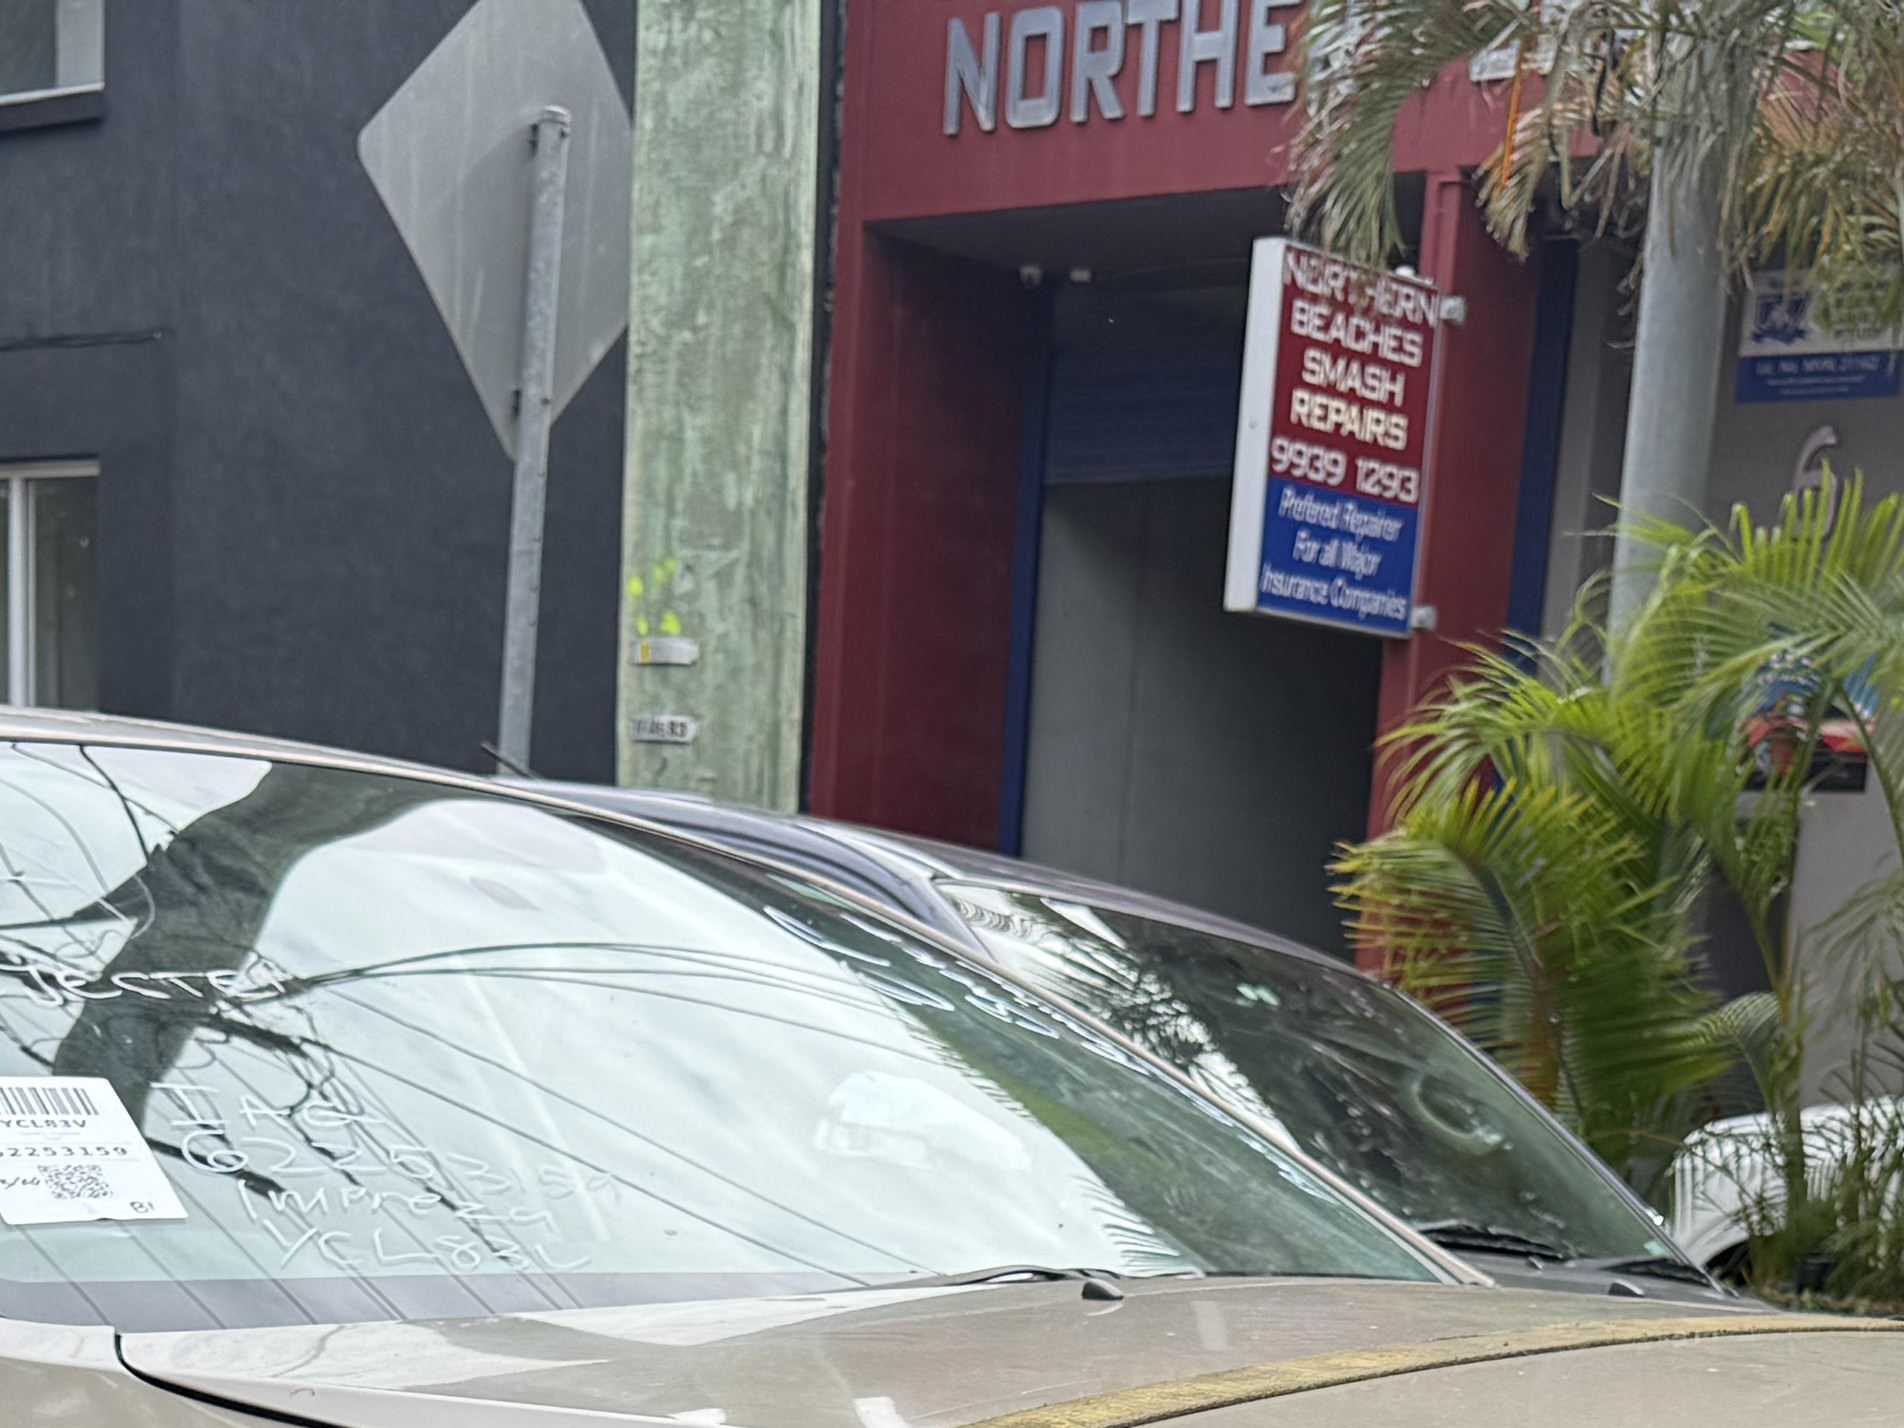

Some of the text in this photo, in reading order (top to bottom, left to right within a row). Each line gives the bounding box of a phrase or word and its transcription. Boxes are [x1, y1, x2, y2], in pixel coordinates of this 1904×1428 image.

[942, 0, 1295, 136] NORTHE
[1290, 299, 1424, 368] BEACHES
[1301, 347, 1406, 407] SMASH
[1289, 387, 1409, 451] REPAIRS
[1270, 436, 1420, 504] 9939 1293
[1292, 528, 1320, 563] For
[1259, 562, 1409, 622] Insurance Companies
